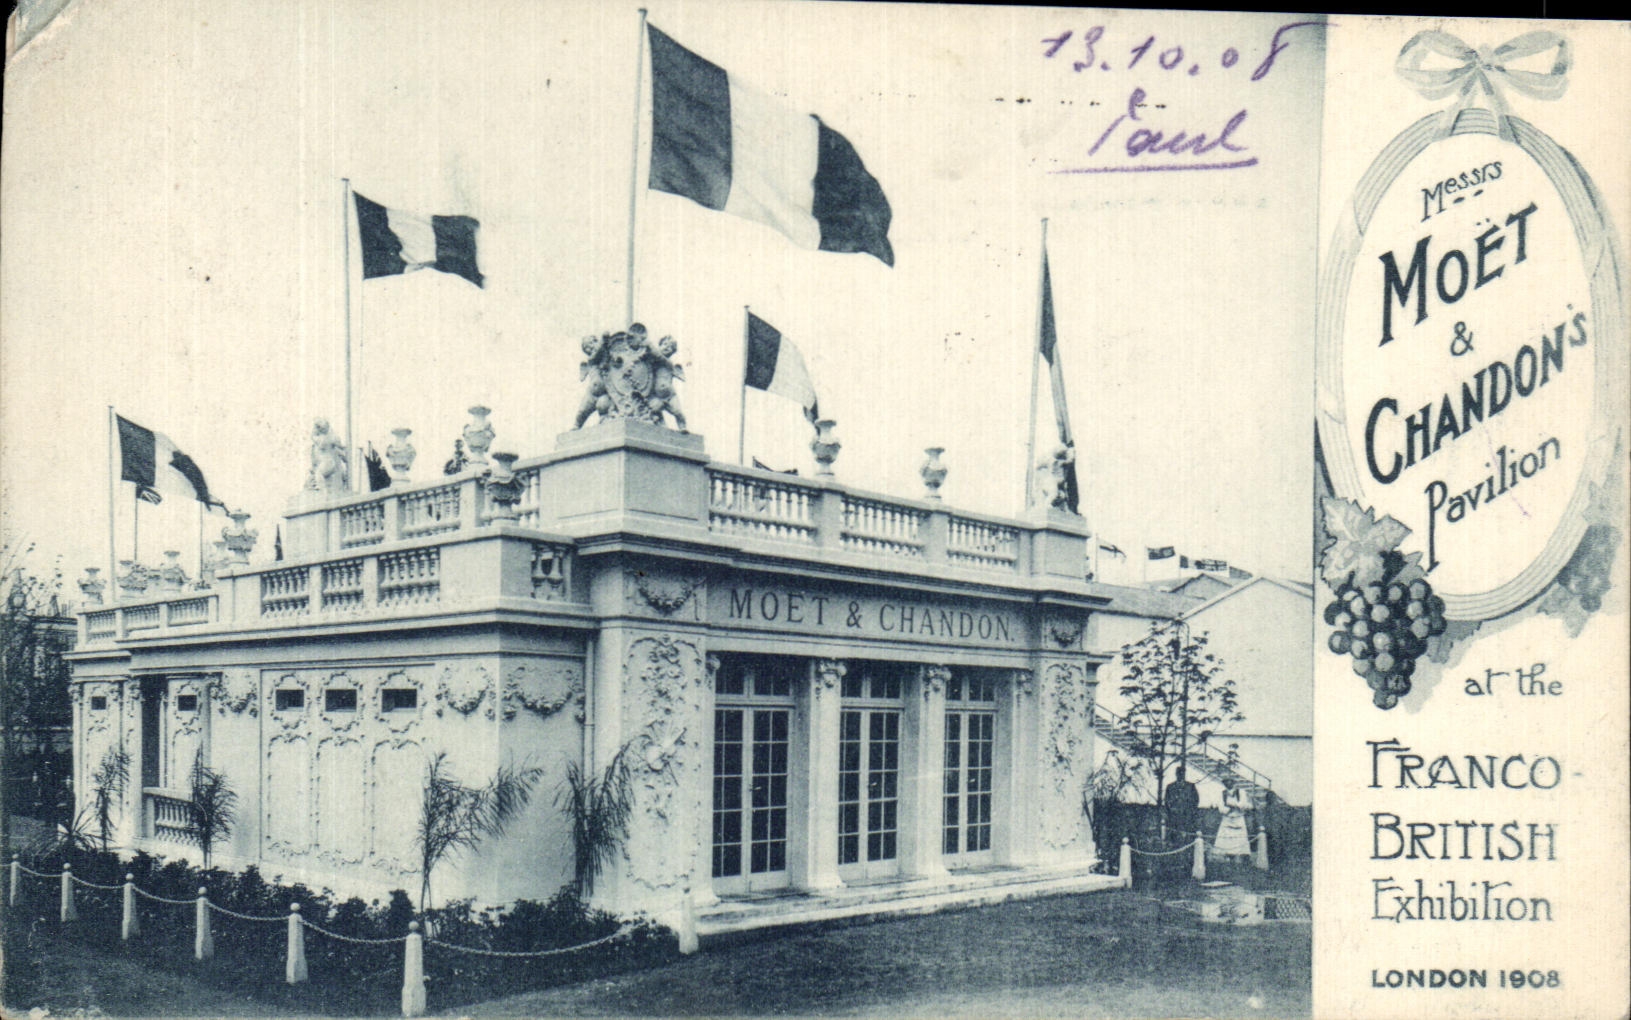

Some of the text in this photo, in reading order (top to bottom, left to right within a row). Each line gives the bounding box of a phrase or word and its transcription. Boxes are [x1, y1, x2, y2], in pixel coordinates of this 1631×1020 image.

[1450, 321, 1474, 356] &
[1424, 435, 1561, 572] Pavilion
[846, 601, 863, 629] &
[1464, 663, 1563, 696] at the
[1369, 812, 1557, 861] BRITISH
[1371, 876, 1553, 923] Exhibition
[1371, 969, 1561, 988] LONDON 1908
